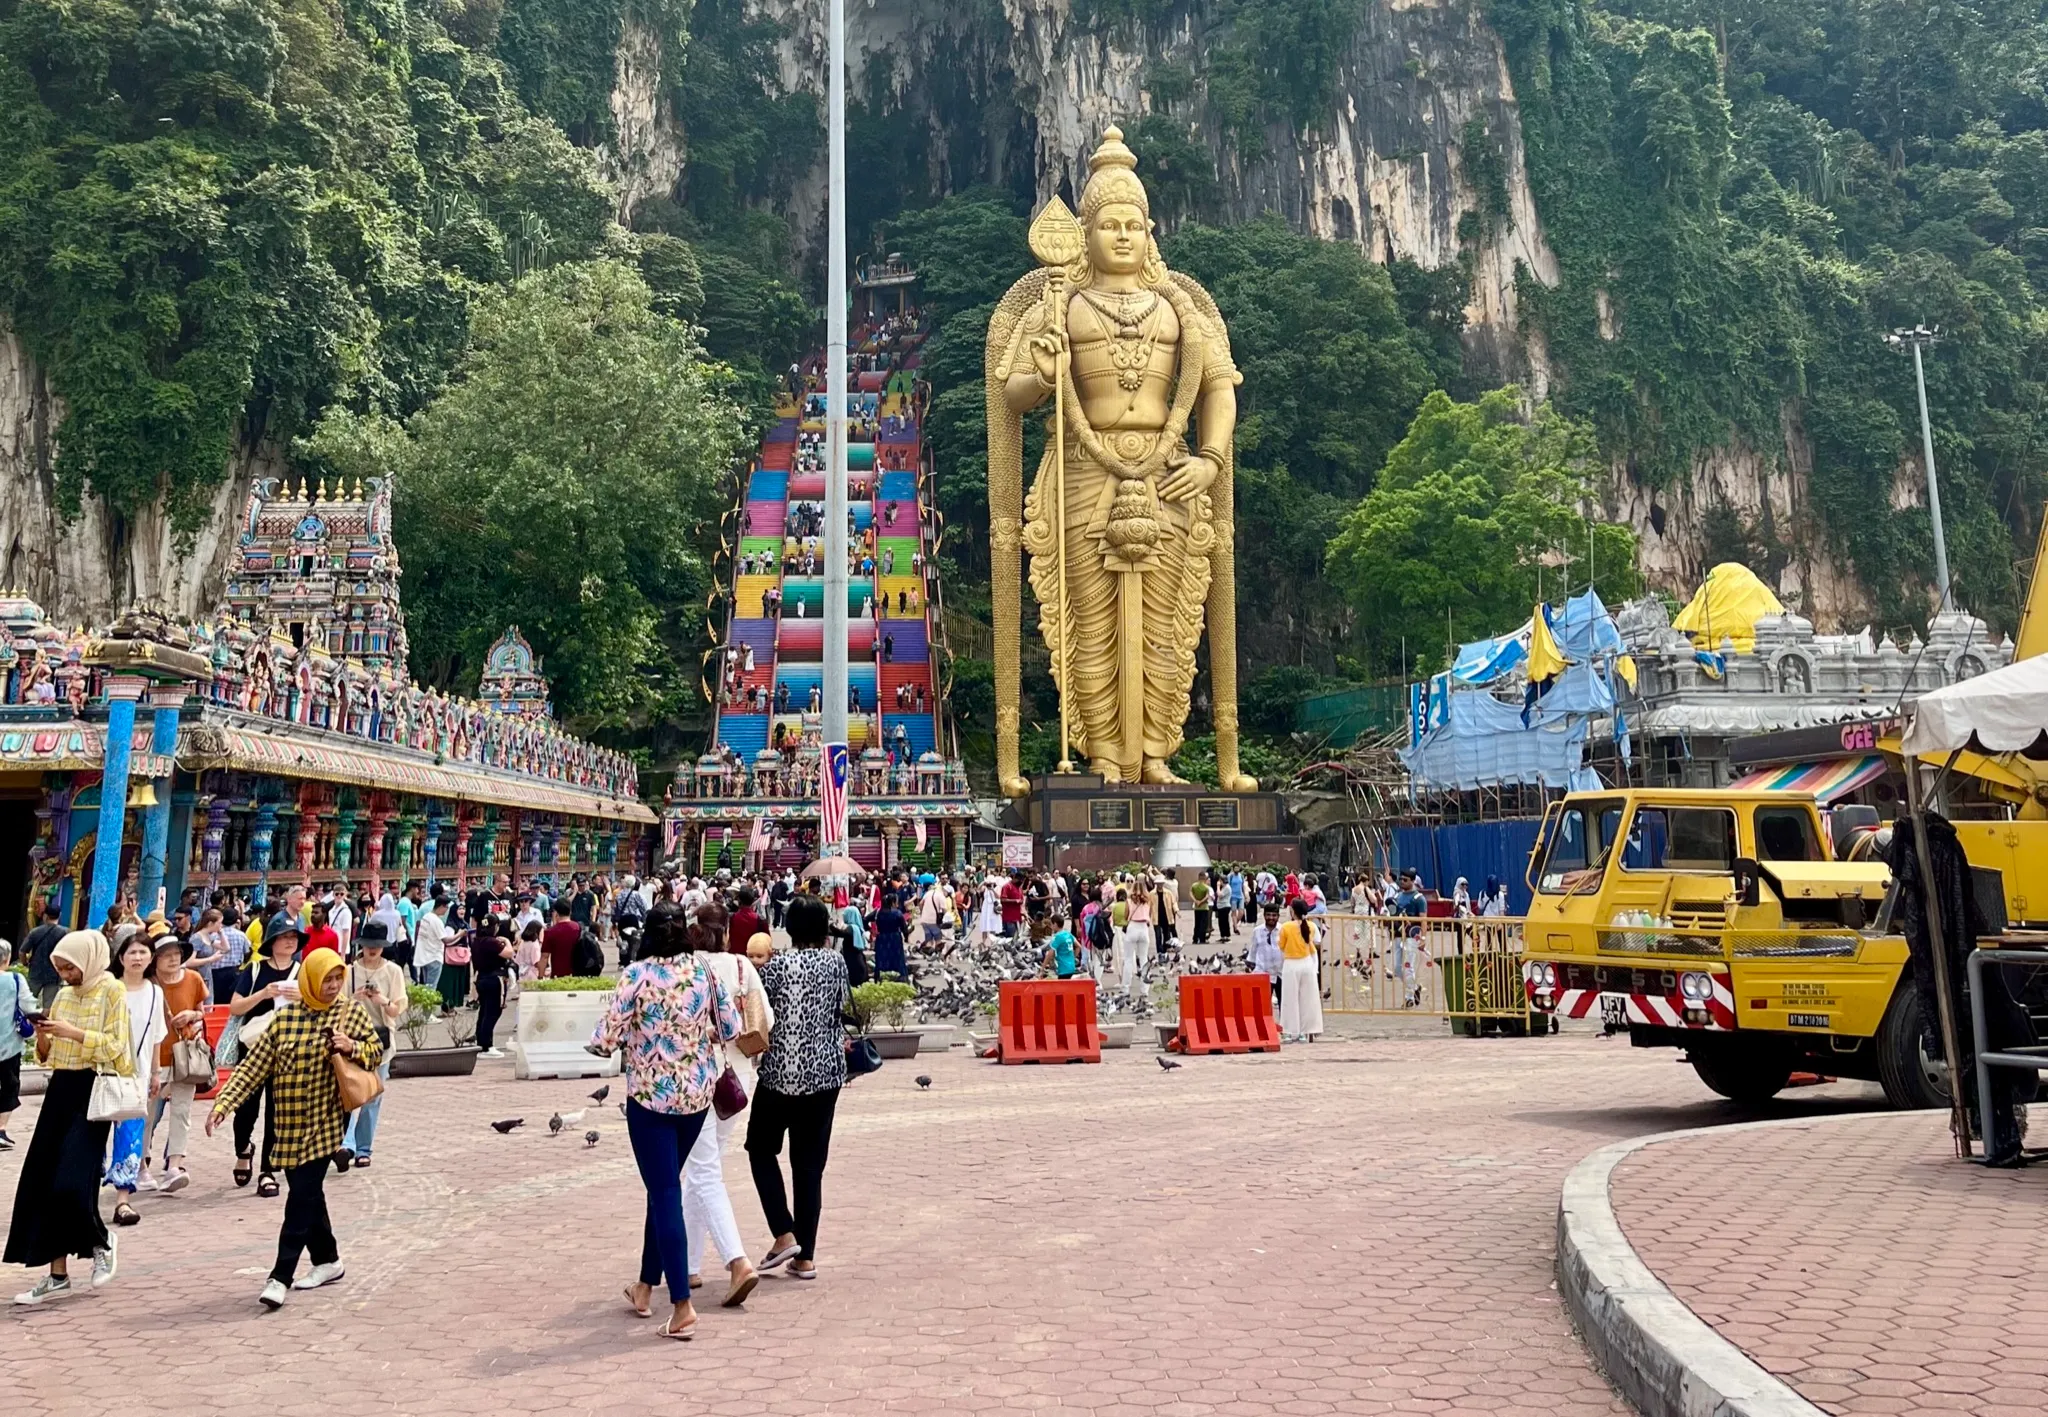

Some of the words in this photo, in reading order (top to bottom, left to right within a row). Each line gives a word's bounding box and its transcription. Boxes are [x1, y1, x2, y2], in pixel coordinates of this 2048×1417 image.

[1841, 721, 1875, 751] GEE
[1567, 966, 1676, 988] FUSO
[1602, 996, 1621, 1010] WFV
[1602, 1010, 1628, 1025] 5874
